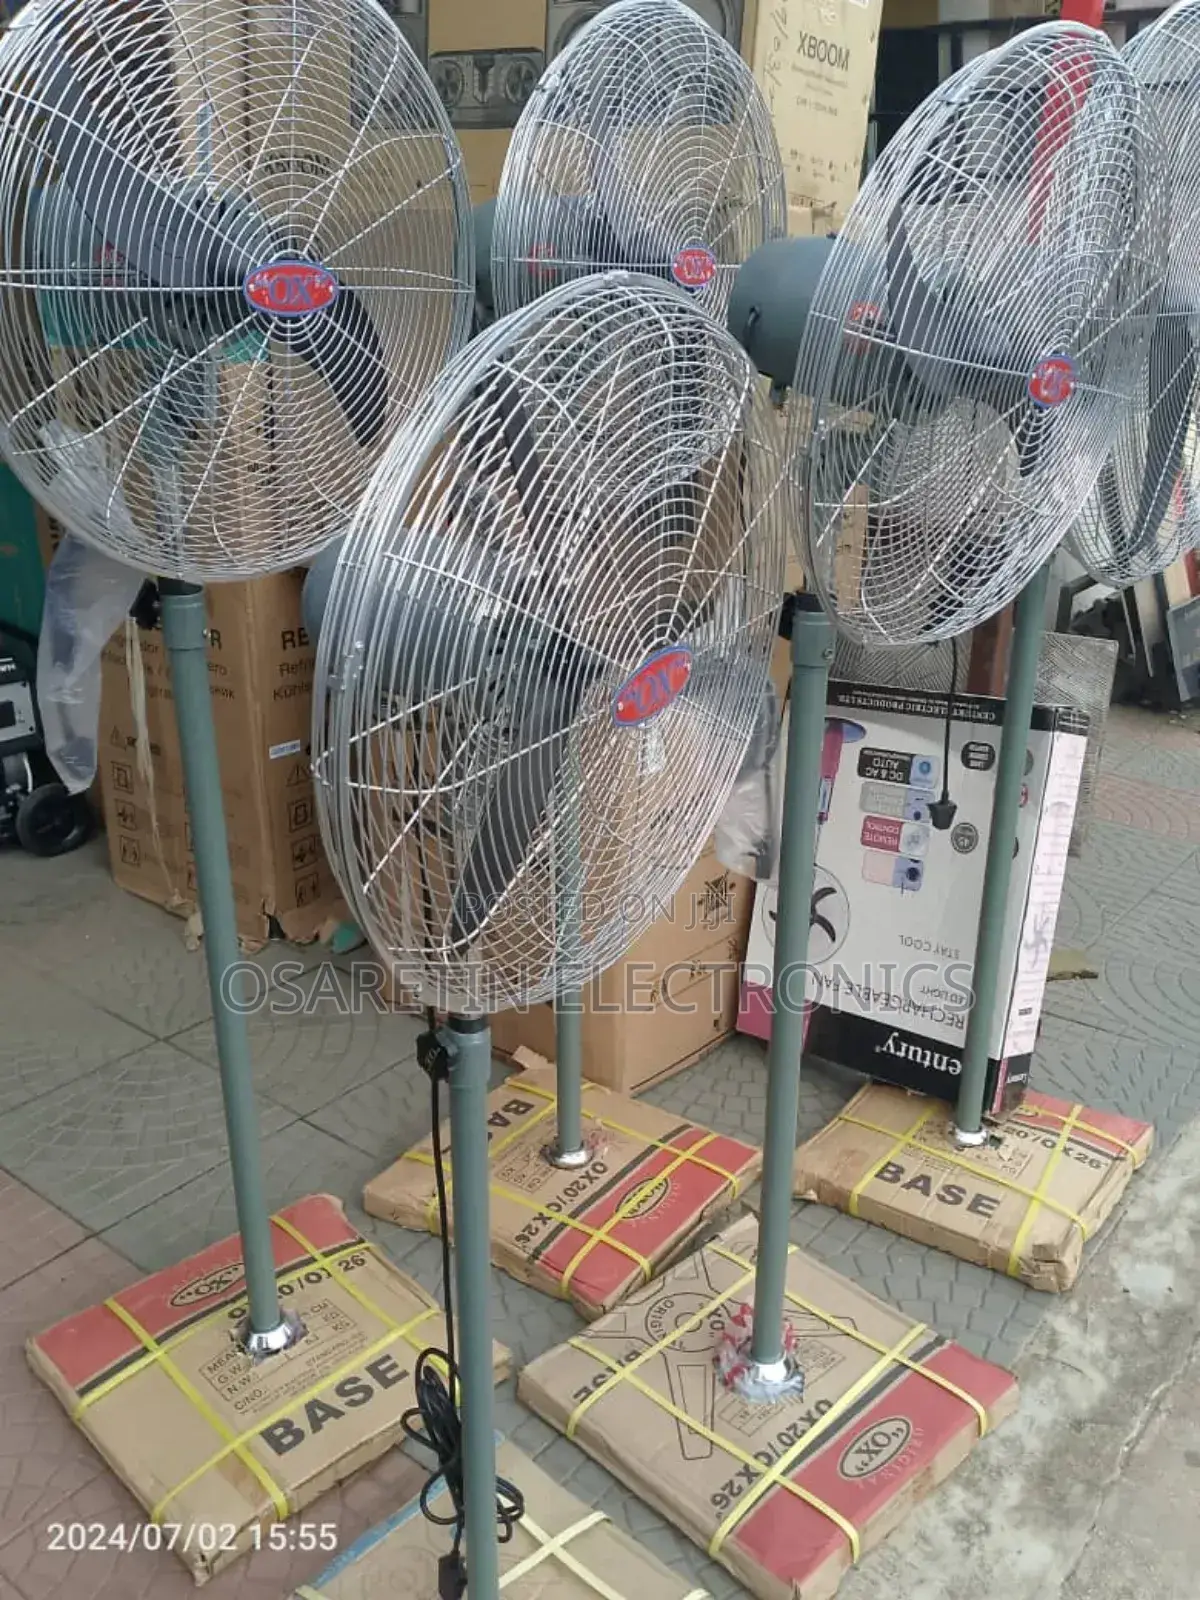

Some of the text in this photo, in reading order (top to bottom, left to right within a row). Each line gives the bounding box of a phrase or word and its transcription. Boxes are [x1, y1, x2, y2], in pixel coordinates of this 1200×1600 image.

[796, 30, 850, 71] XBOOM
[872, 757, 899, 769] AUTO
[863, 830, 898, 847] REMOTE
[899, 934, 961, 960] STAY COOL
[881, 1031, 963, 1076] entury
[874, 1161, 1001, 1219] BASE
[258, 1353, 411, 1456] BASE
